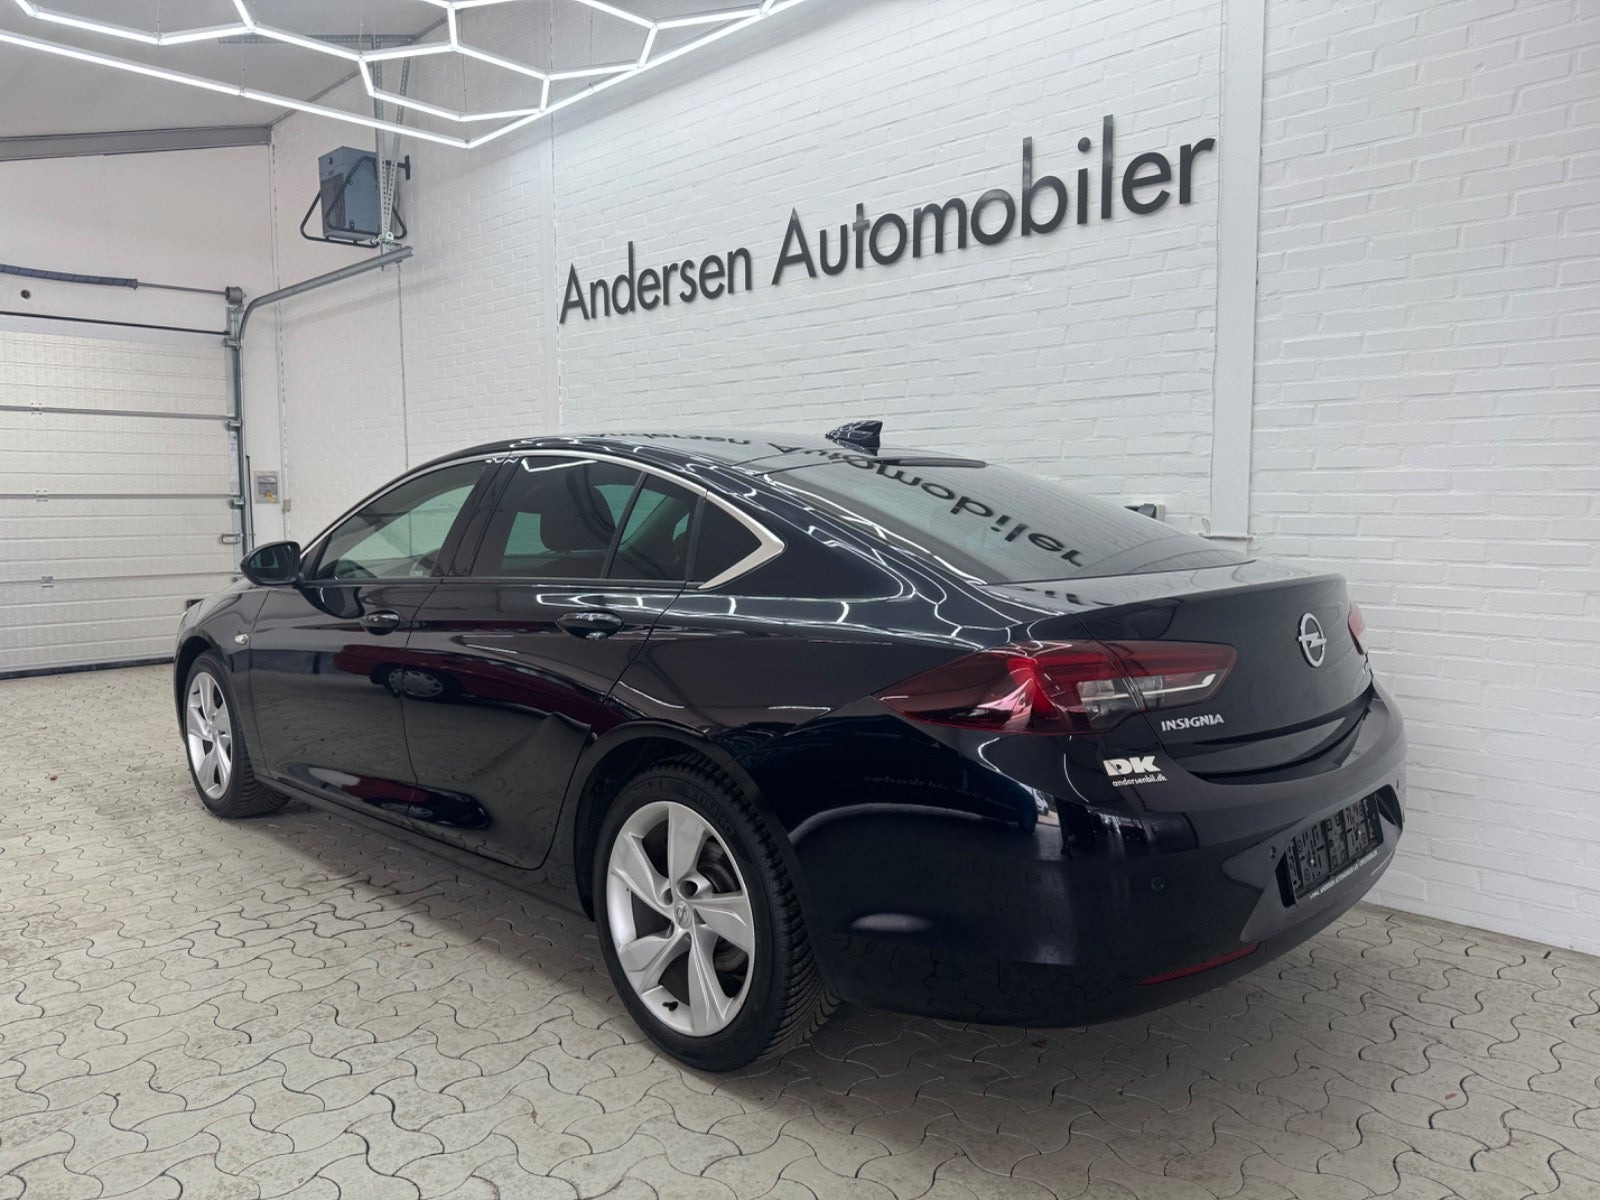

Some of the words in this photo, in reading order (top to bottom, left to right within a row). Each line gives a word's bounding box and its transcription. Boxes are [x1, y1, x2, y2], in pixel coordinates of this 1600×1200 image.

[559, 240, 753, 325] Andersen
[770, 114, 1215, 284] Automobiler
[1161, 713, 1225, 732] INSIGNIA
[1103, 756, 1161, 776] DK
